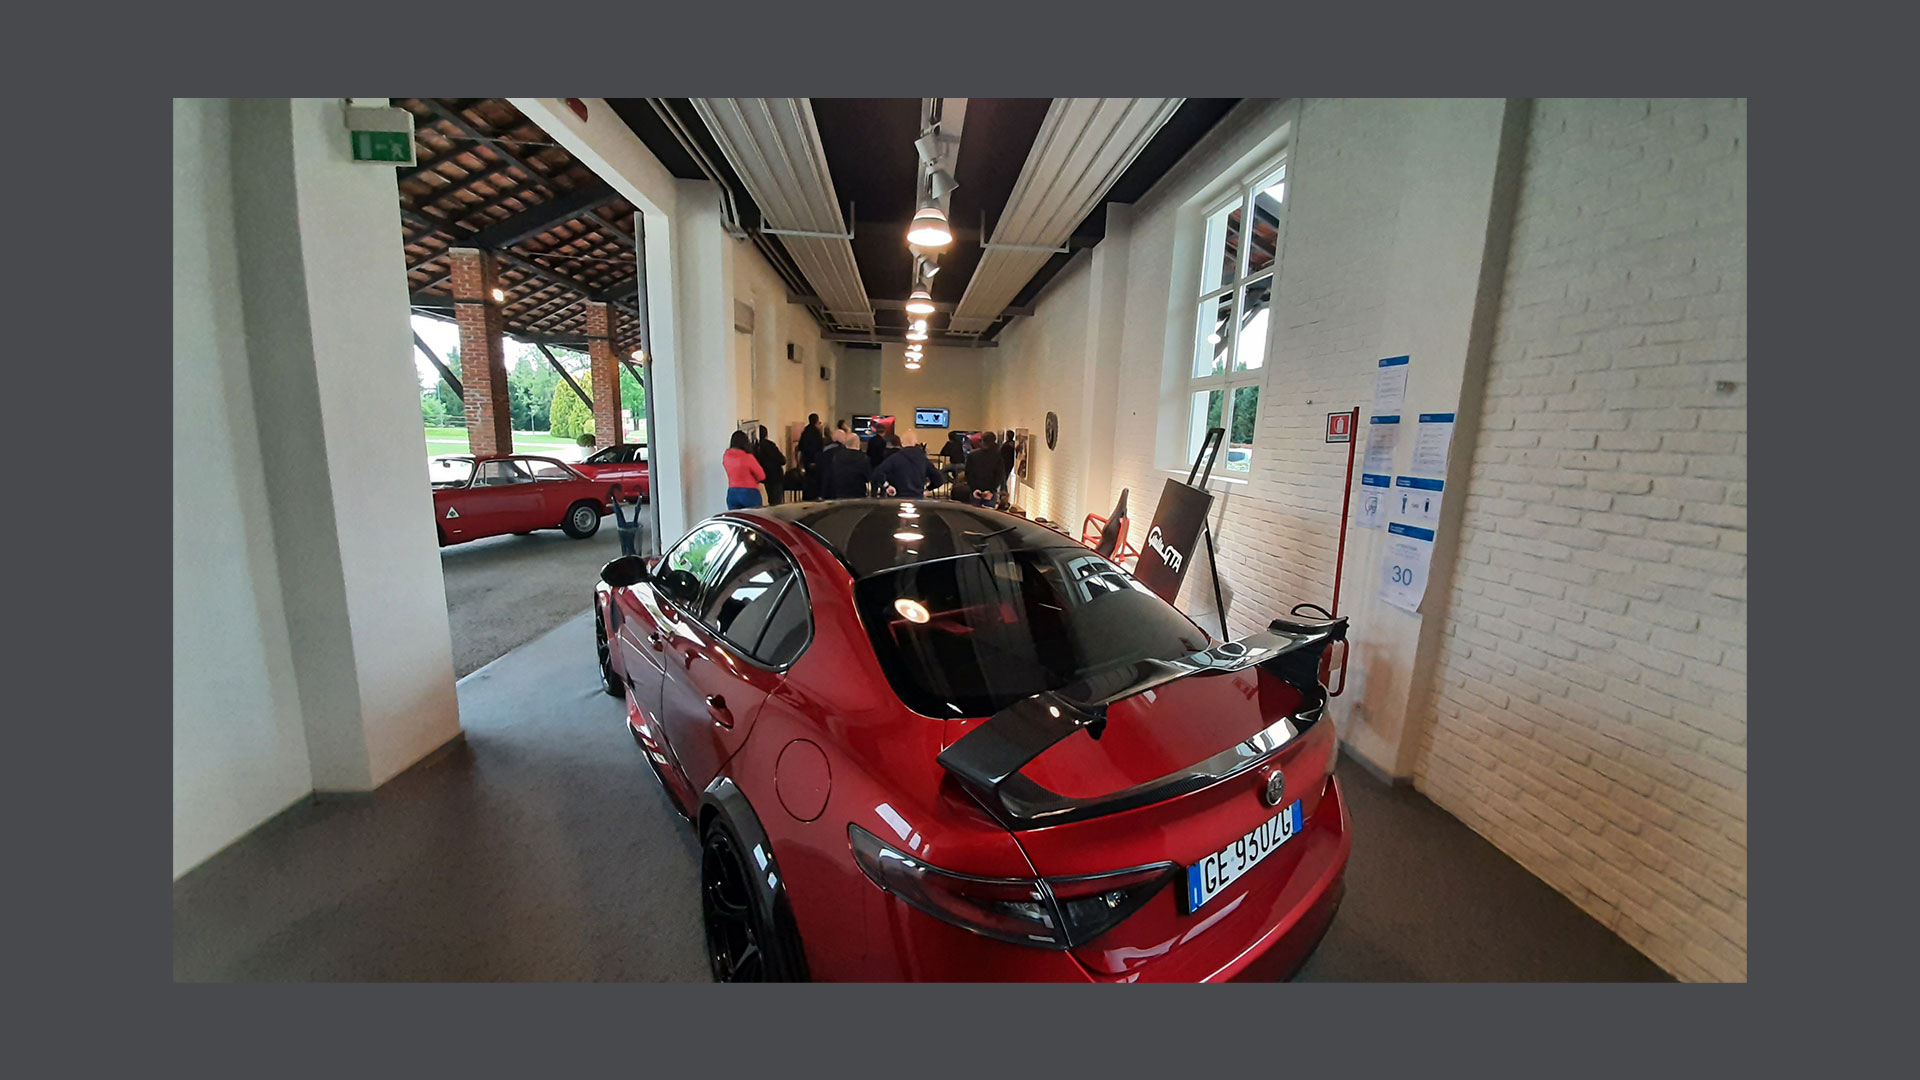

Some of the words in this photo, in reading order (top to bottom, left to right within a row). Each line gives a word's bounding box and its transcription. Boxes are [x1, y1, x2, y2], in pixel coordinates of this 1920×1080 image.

[1164, 545, 1183, 574] GTA
[1392, 565, 1413, 586] 30
[1204, 852, 1230, 894] GE
[1235, 807, 1291, 871] 930ZG
